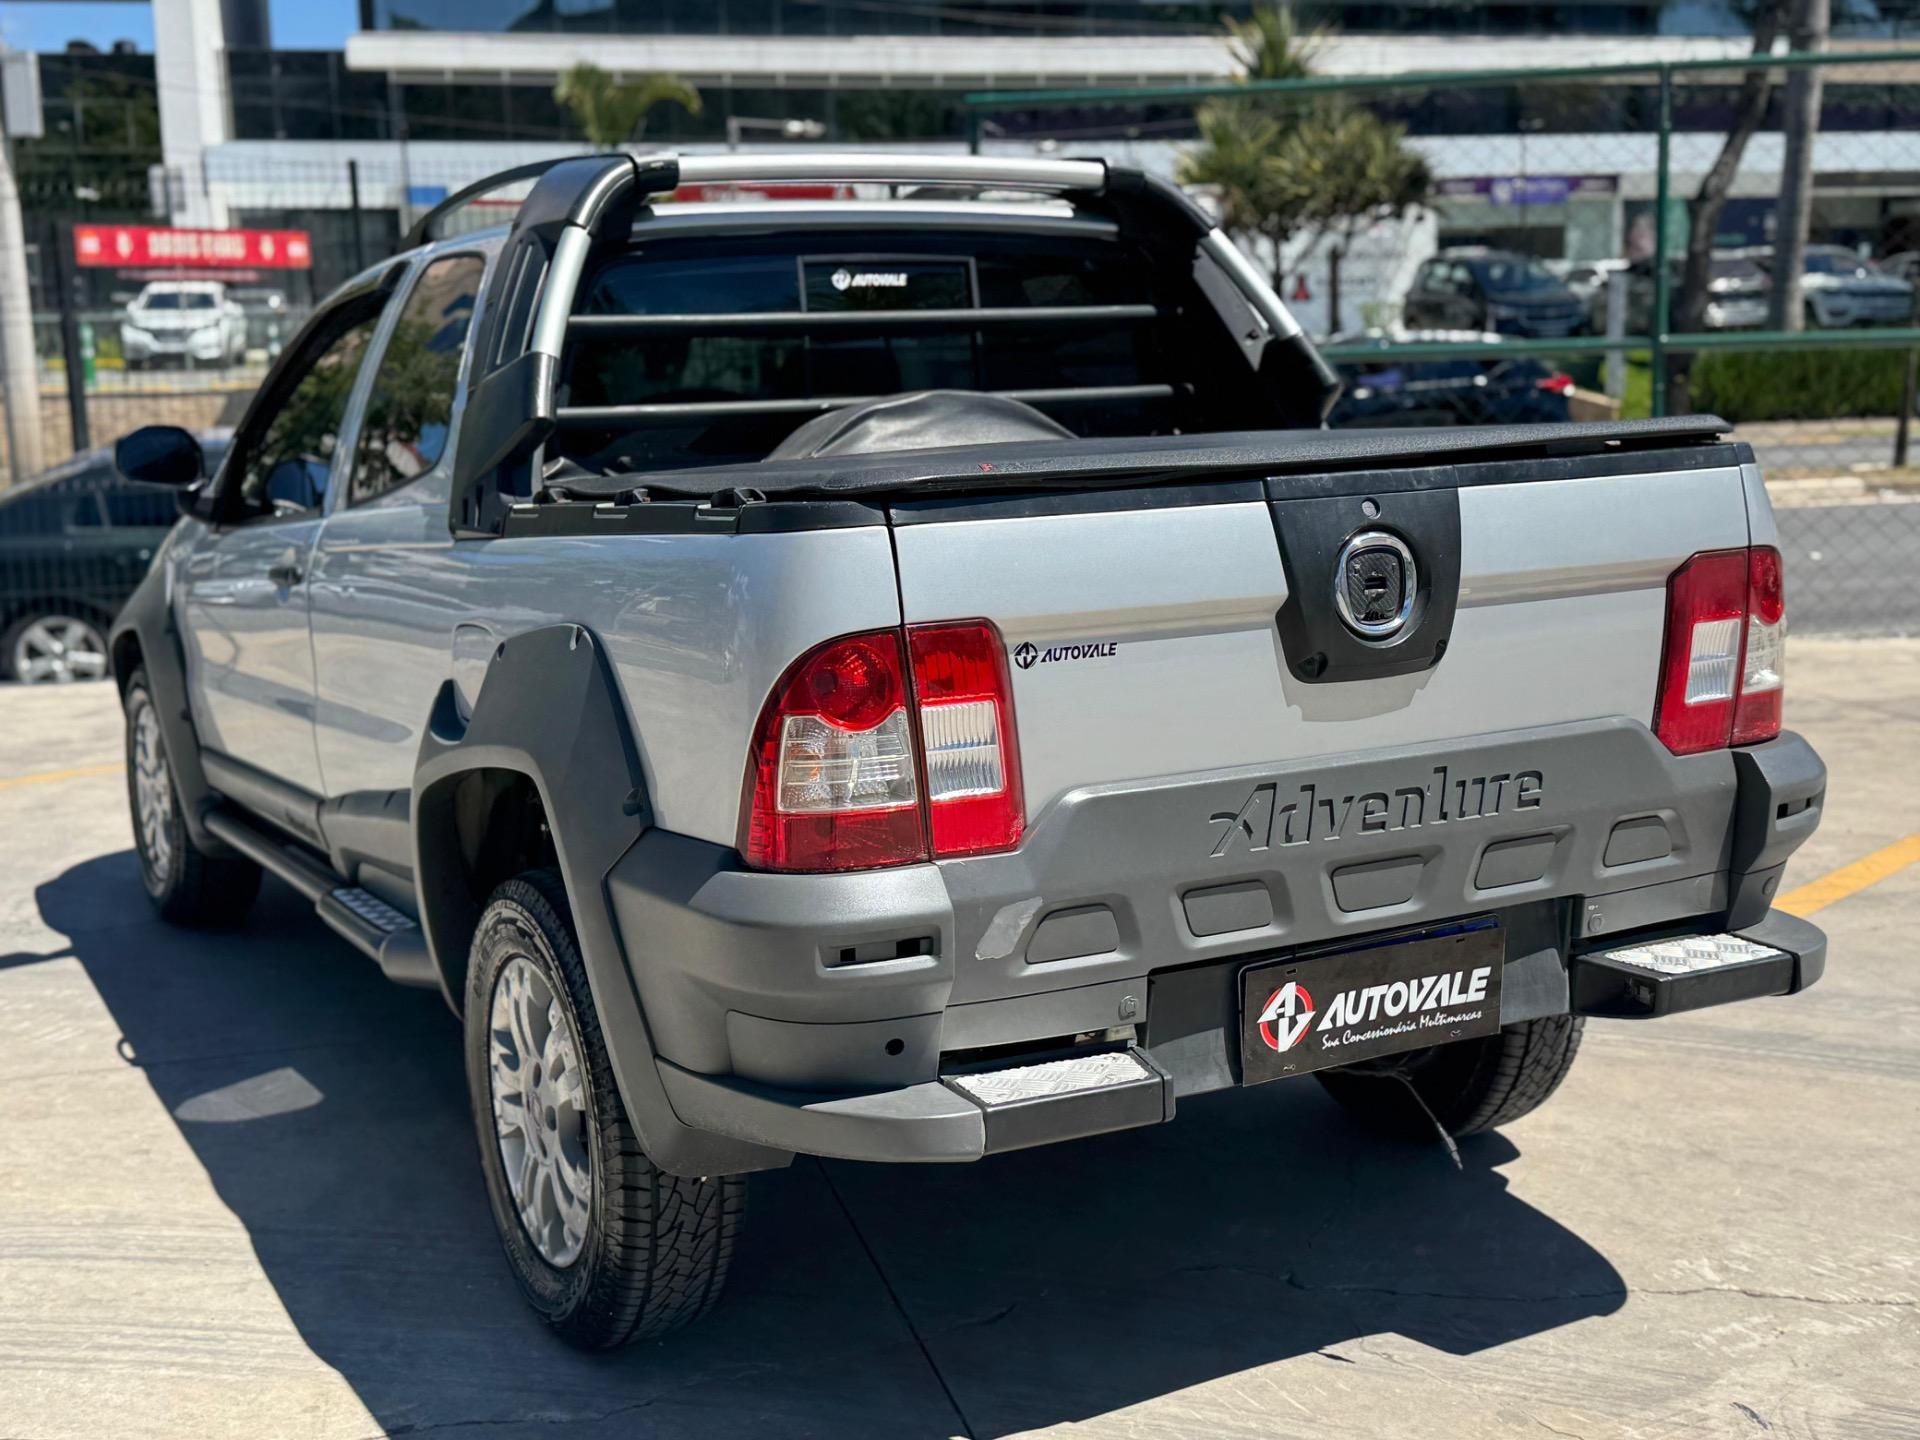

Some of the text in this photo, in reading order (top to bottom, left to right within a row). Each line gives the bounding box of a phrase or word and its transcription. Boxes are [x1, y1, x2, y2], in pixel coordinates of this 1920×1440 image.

[851, 273, 908, 287] AUTOVALE
[1040, 642, 1118, 663] AUTOVALE
[1209, 766, 1543, 858] Adventure
[1316, 966, 1492, 1032] AUTOVALE
[1321, 1010, 1482, 1050] Sua Concessionária Multimarcas
